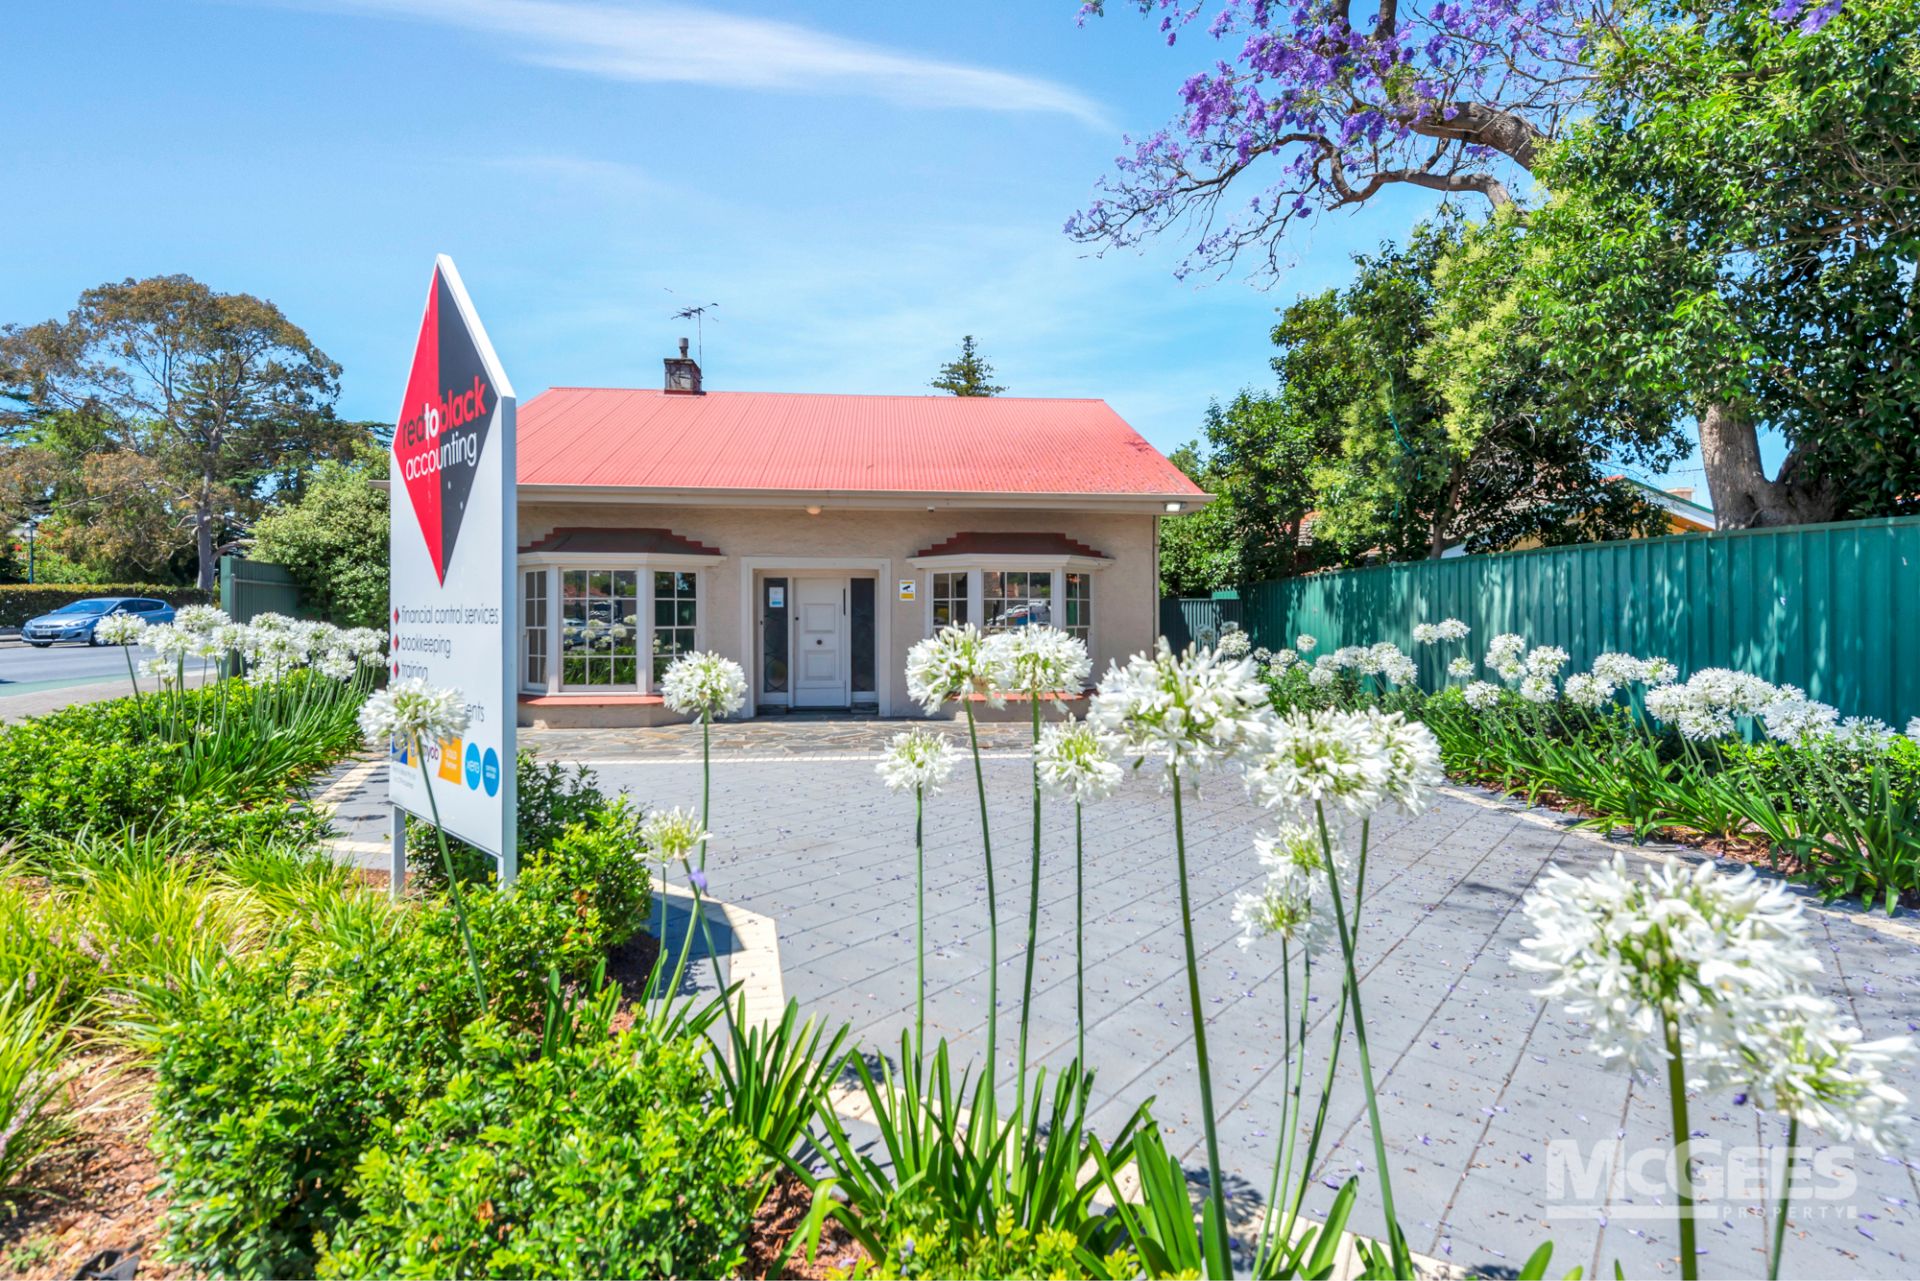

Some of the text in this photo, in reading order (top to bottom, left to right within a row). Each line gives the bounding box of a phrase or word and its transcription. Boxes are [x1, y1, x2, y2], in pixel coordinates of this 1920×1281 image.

[406, 431, 477, 481] accounting
[401, 603, 499, 624] financial control services
[401, 633, 451, 659] bookkeeping
[401, 661, 429, 681] training
